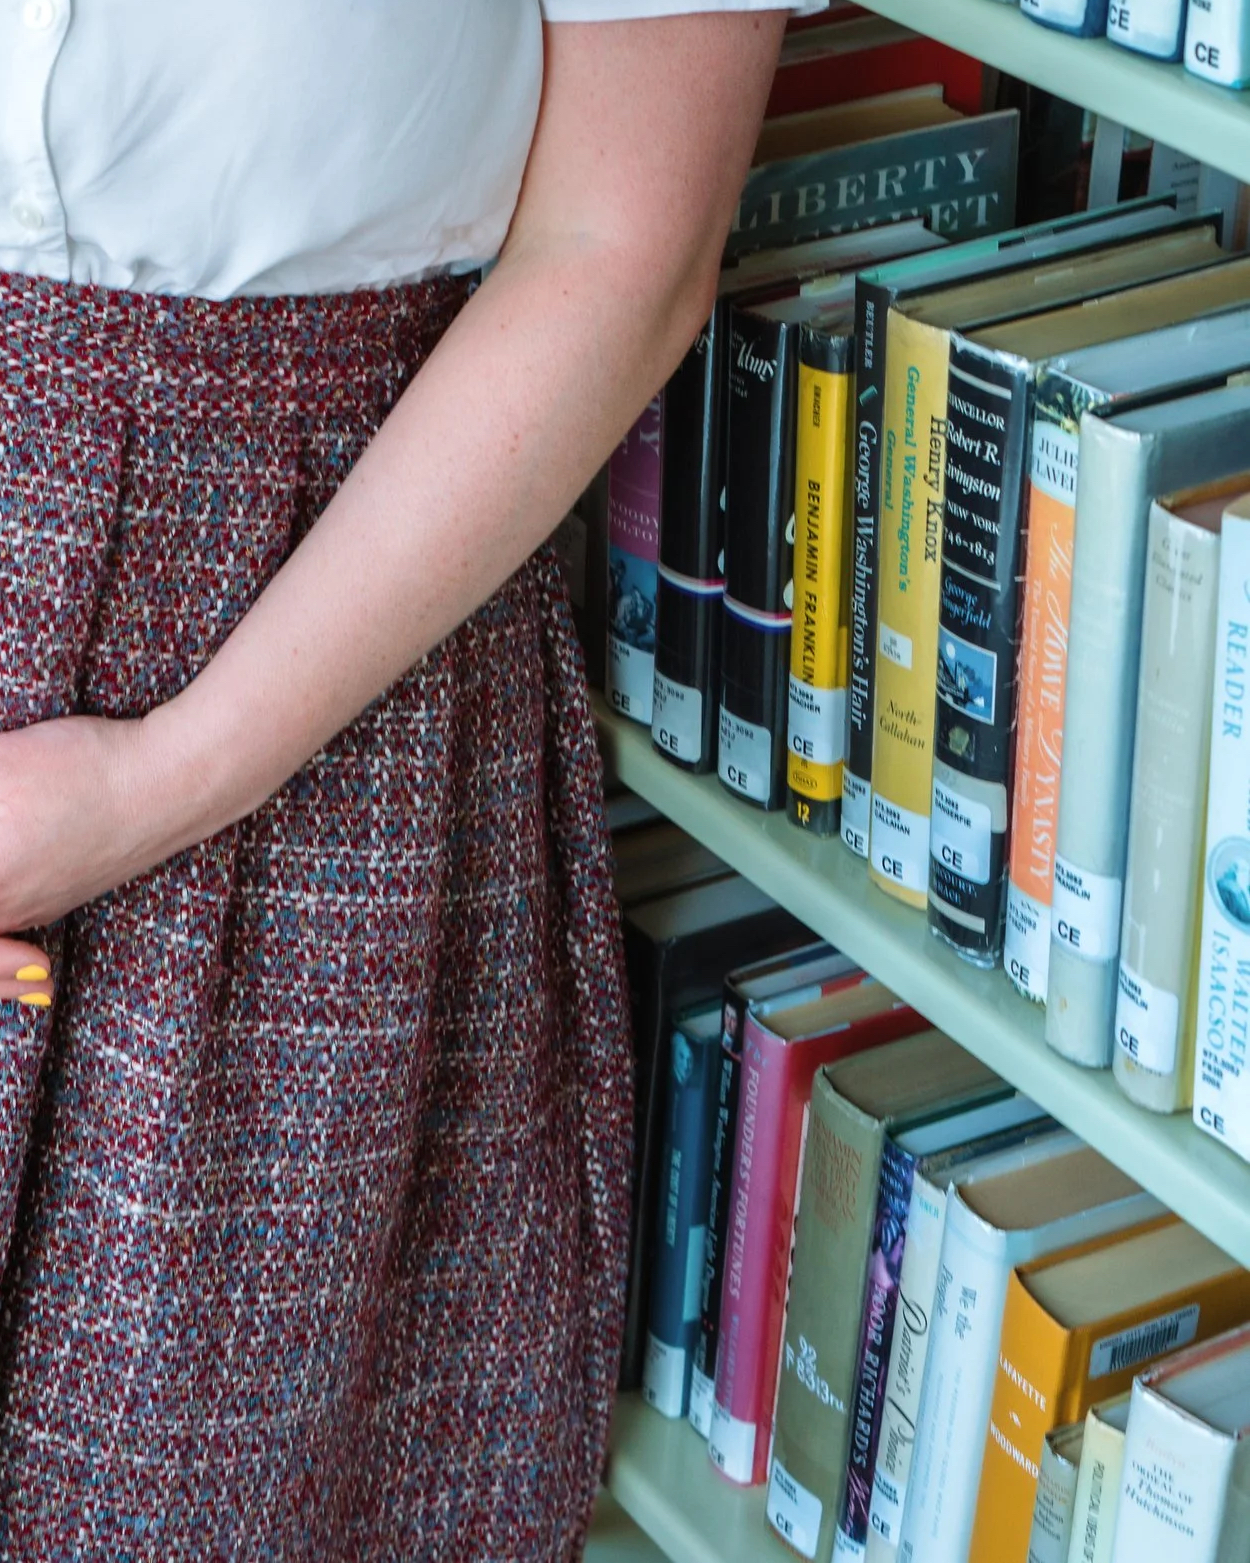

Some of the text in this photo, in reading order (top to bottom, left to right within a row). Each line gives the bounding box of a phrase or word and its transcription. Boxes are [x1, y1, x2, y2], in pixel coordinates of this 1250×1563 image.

[1108, 5, 1130, 32] CE
[1195, 42, 1220, 69] CE
[732, 148, 989, 234] LIBERTY
[946, 419, 1001, 466] Robert R.
[1039, 437, 1077, 470] JULIE
[884, 429, 897, 511] General
[897, 365, 921, 593] General Washington's
[924, 414, 947, 564] Henry Knox
[850, 299, 878, 731] BEUTLER George Washington's Hair
[947, 502, 1001, 536] NEW YORK
[800, 479, 821, 686] BENJAMIN FRANKLIN
[944, 574, 979, 604] George
[1222, 619, 1248, 740] READER
[612, 690, 631, 713] CE
[659, 727, 679, 753] CE
[792, 734, 814, 759] CE
[879, 718, 926, 750] Callahan
[727, 765, 748, 790] CE
[797, 801, 810, 823] 12
[874, 809, 911, 837] CALLAHAN
[845, 829, 864, 854] CE
[881, 854, 903, 880] CE
[942, 844, 963, 871] CE
[1055, 872, 1091, 901] FRANKLIN
[1058, 919, 1081, 948] CE
[1010, 958, 1030, 987] CE
[1119, 1026, 1139, 1056] CE
[1200, 1106, 1225, 1134] CE
[729, 1190, 751, 1300] FORTUNES
[896, 1286, 929, 1398] Patriot's
[853, 1283, 888, 1469] POOR RICHARD'S
[998, 1350, 1047, 1414] LAFAYETTE
[990, 1417, 1040, 1480] WOODWARD
[776, 1511, 793, 1537] CE
[871, 1512, 891, 1540] CE
